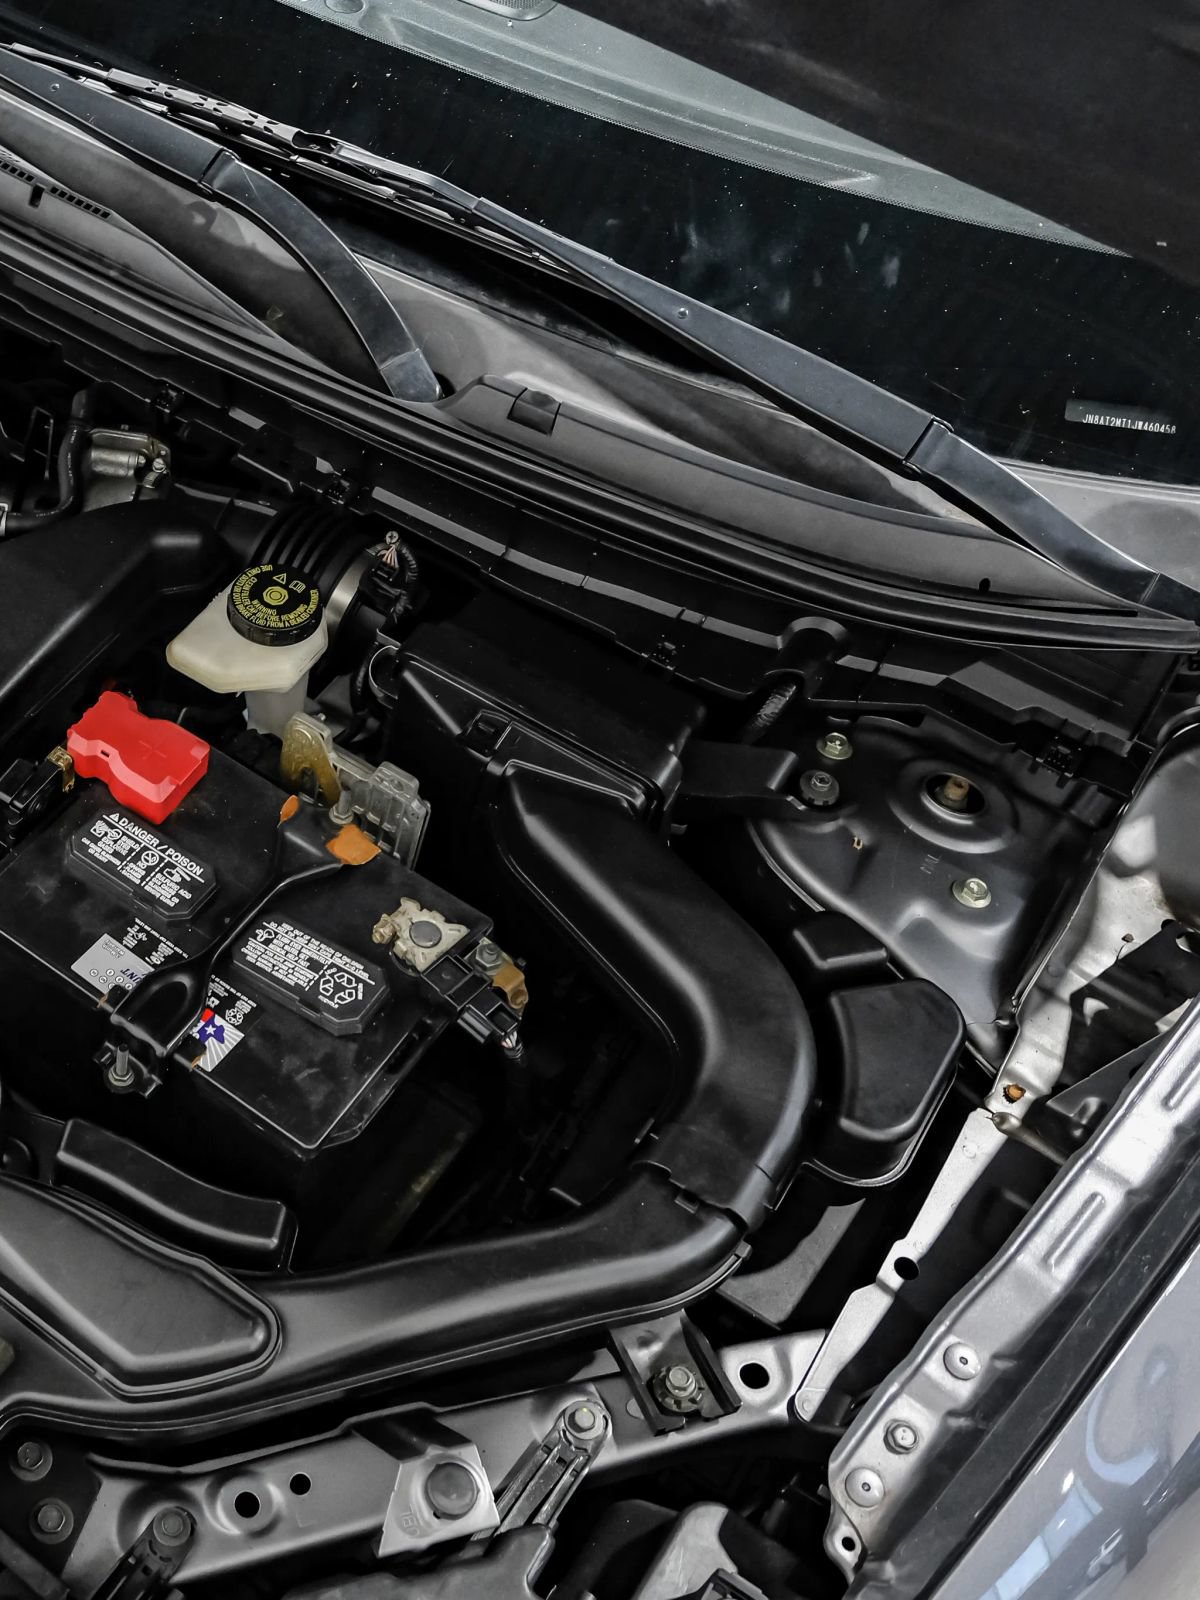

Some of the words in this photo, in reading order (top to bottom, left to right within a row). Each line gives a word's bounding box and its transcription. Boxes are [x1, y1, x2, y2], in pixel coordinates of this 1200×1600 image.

[247, 567, 260, 577] ONLY
[243, 577, 257, 590] CLEAN
[242, 591, 250, 605] FILLER
[236, 605, 252, 619] BRAKE
[246, 605, 257, 613] CAP
[252, 600, 276, 615] WARNING
[281, 604, 307, 621] REMOVING
[250, 616, 266, 625] FLUID
[256, 612, 280, 621] BEFORE
[290, 613, 310, 625] SEALED
[119, 818, 159, 847] DANGER
[165, 848, 203, 875] POISON
[136, 861, 147, 869] NO
[155, 873, 180, 891] SULFURIC
[178, 889, 192, 899] ACID
[281, 923, 293, 931] KEEP
[310, 938, 320, 946] THE
[319, 943, 335, 954] REACH
[286, 953, 298, 961] HELP
[308, 942, 320, 950] VENT
[345, 963, 356, 971] AND
